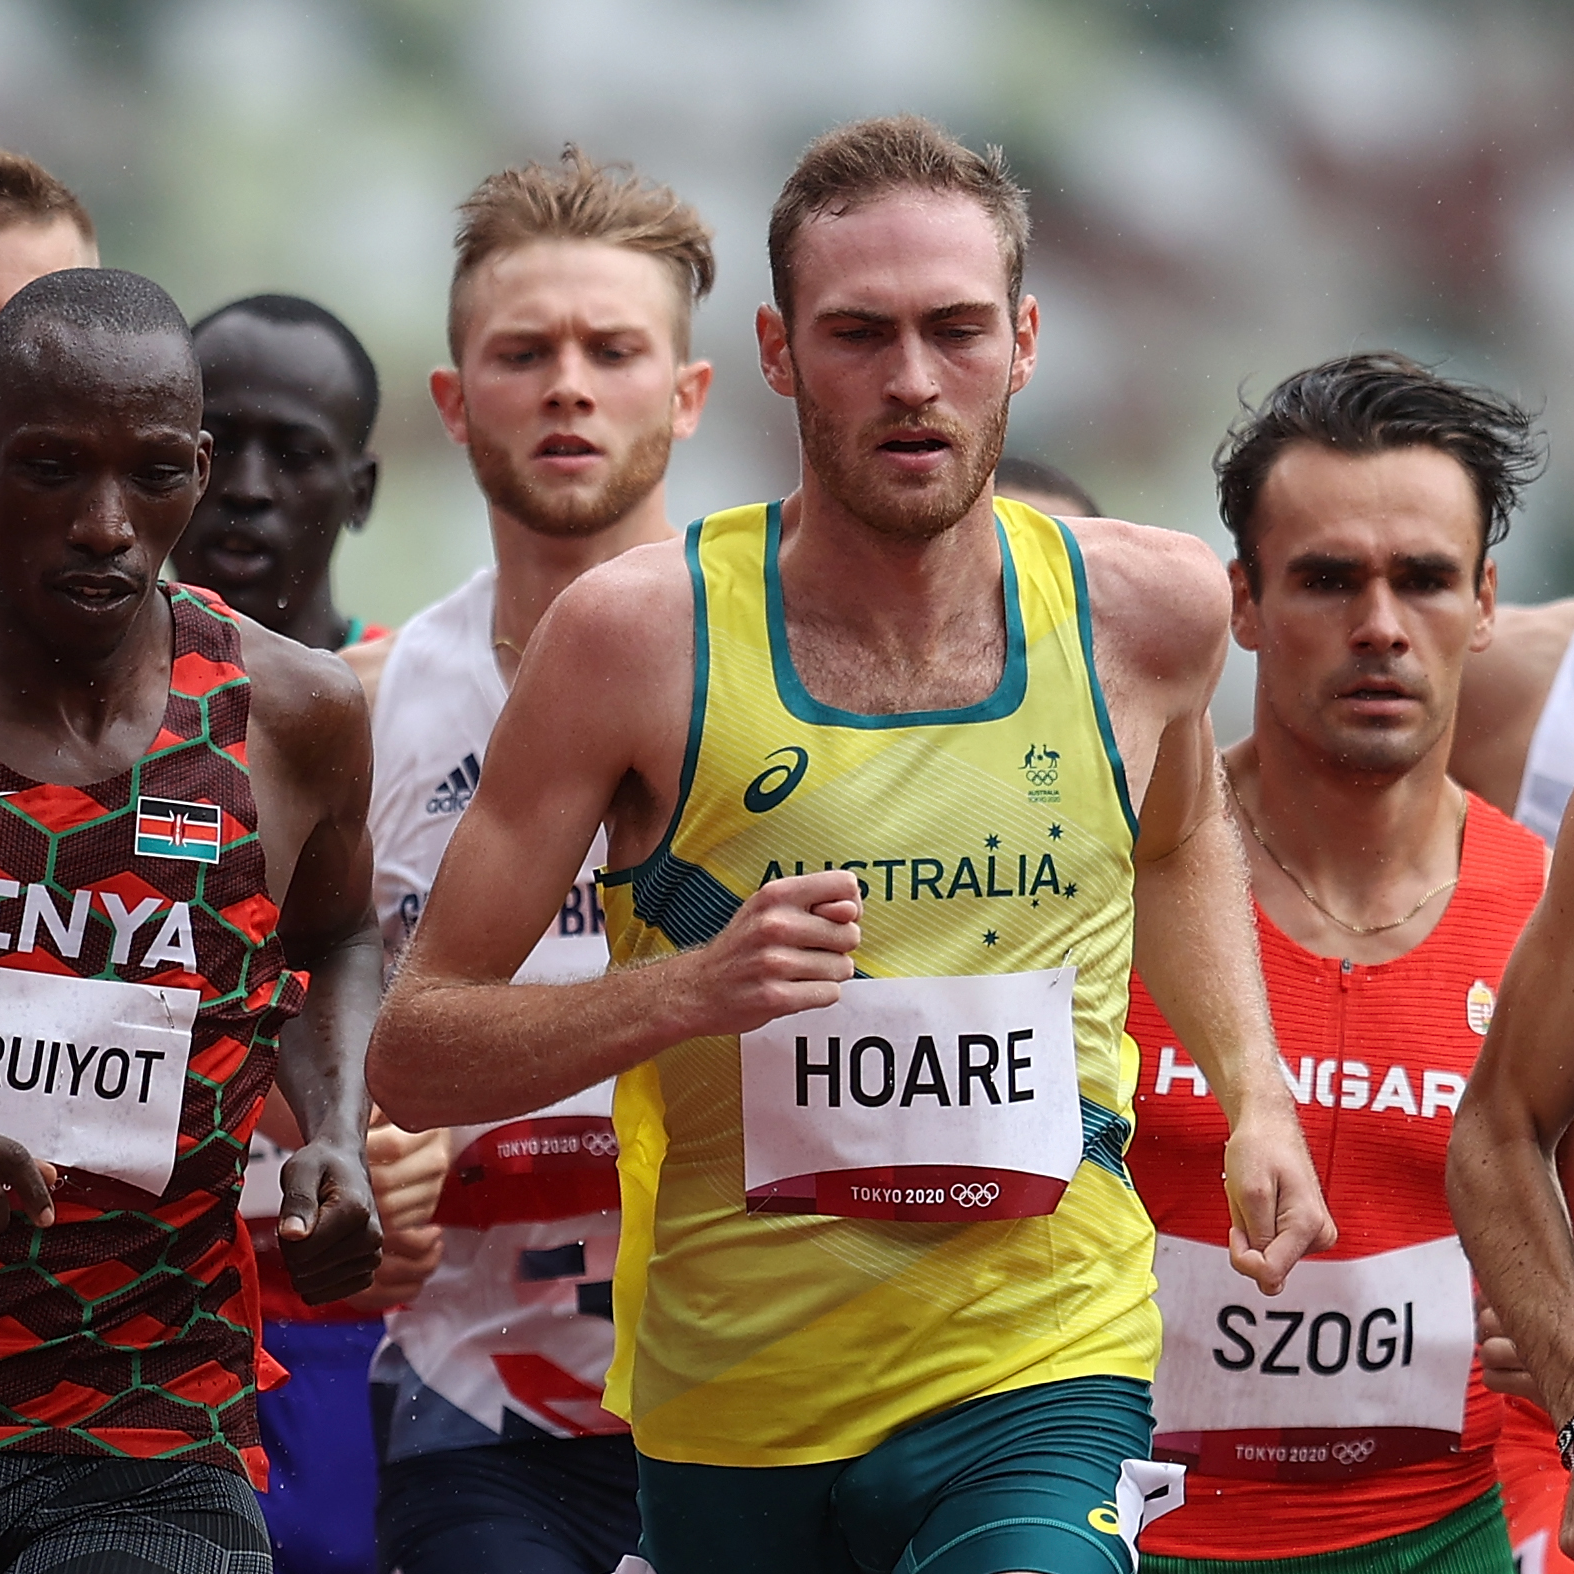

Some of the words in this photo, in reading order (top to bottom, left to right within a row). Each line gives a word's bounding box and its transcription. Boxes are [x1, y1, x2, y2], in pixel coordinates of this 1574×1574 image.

[760, 853, 1060, 901] ASTRALIA
[794, 1030, 1034, 1107] HOARE
[1154, 1046, 1466, 1118] HNGAR
[497, 1138, 540, 1158] TOKYO
[541, 1137, 579, 1155] 2020
[850, 1187, 902, 1204] TOKYO
[905, 1187, 945, 1204] 2020
[1213, 1302, 1413, 1376] SZOGI
[1235, 1445, 1285, 1461] TOKYO
[1288, 1447, 1326, 1461] 2020
